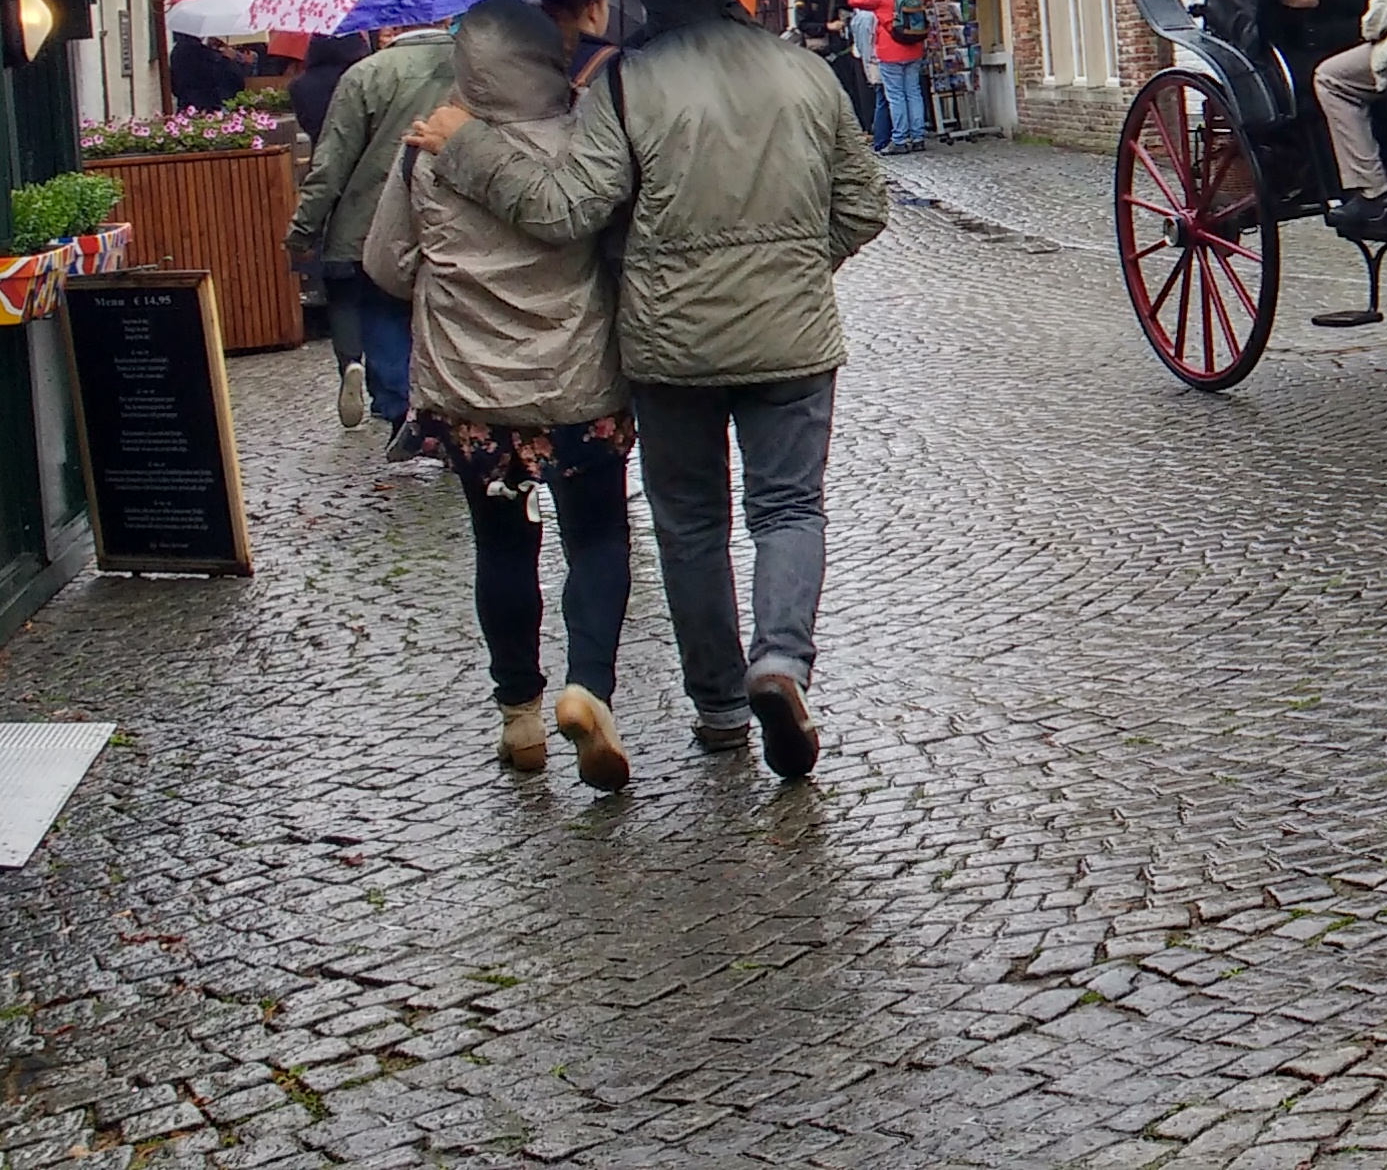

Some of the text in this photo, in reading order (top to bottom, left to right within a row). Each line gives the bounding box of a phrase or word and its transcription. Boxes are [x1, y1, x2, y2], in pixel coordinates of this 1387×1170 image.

[94, 295, 172, 307] Menu € 14,95
